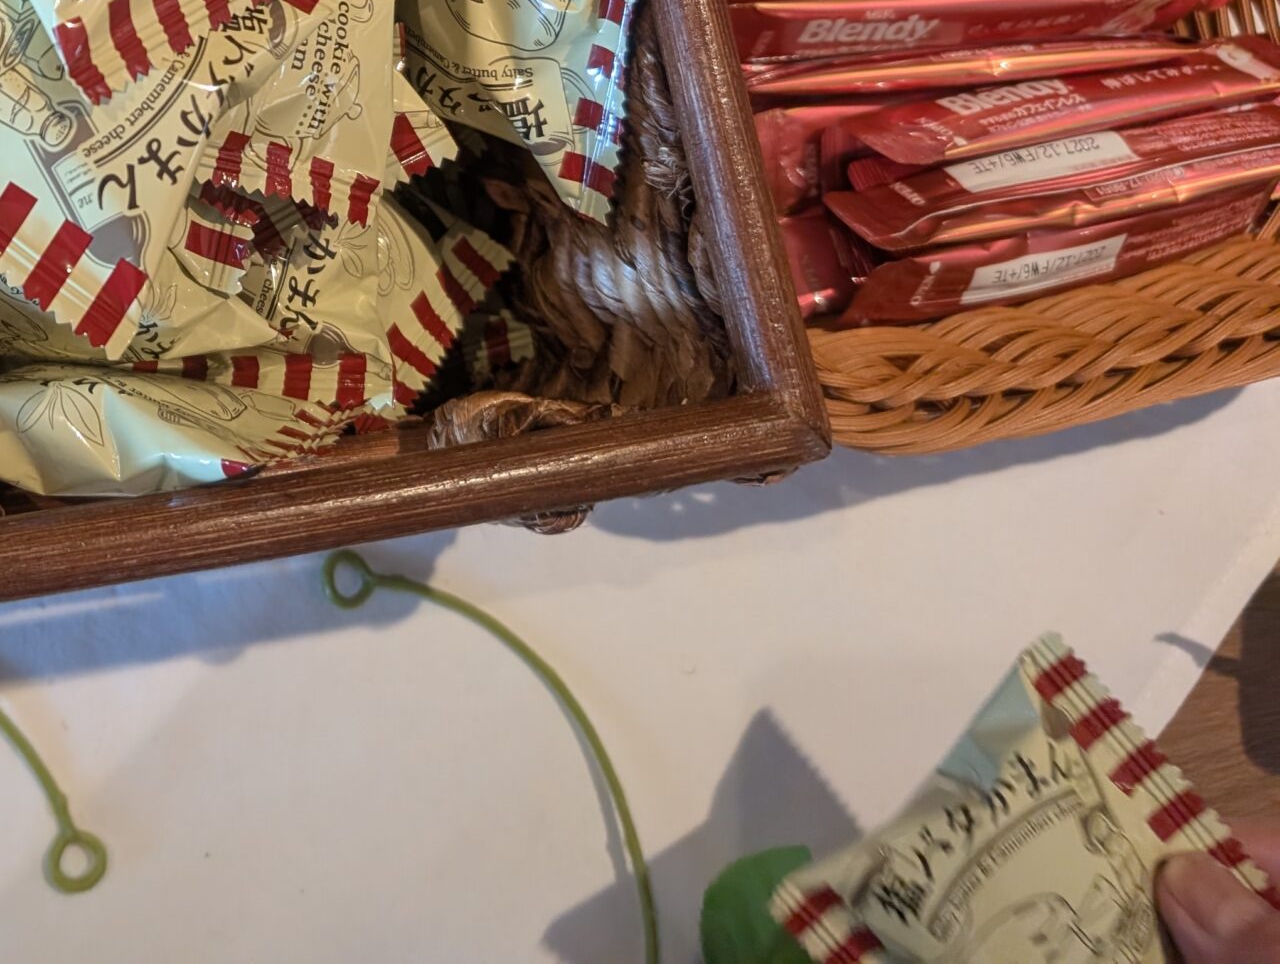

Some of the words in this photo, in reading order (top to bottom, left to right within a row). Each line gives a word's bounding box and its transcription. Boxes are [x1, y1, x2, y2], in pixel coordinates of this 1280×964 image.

[304, 19, 333, 98] cheese
[329, 0, 351, 76] cookie
[797, 13, 941, 45] Blendy
[129, 56, 187, 128] Camembert
[308, 82, 336, 136] with
[82, 126, 128, 159] cheese
